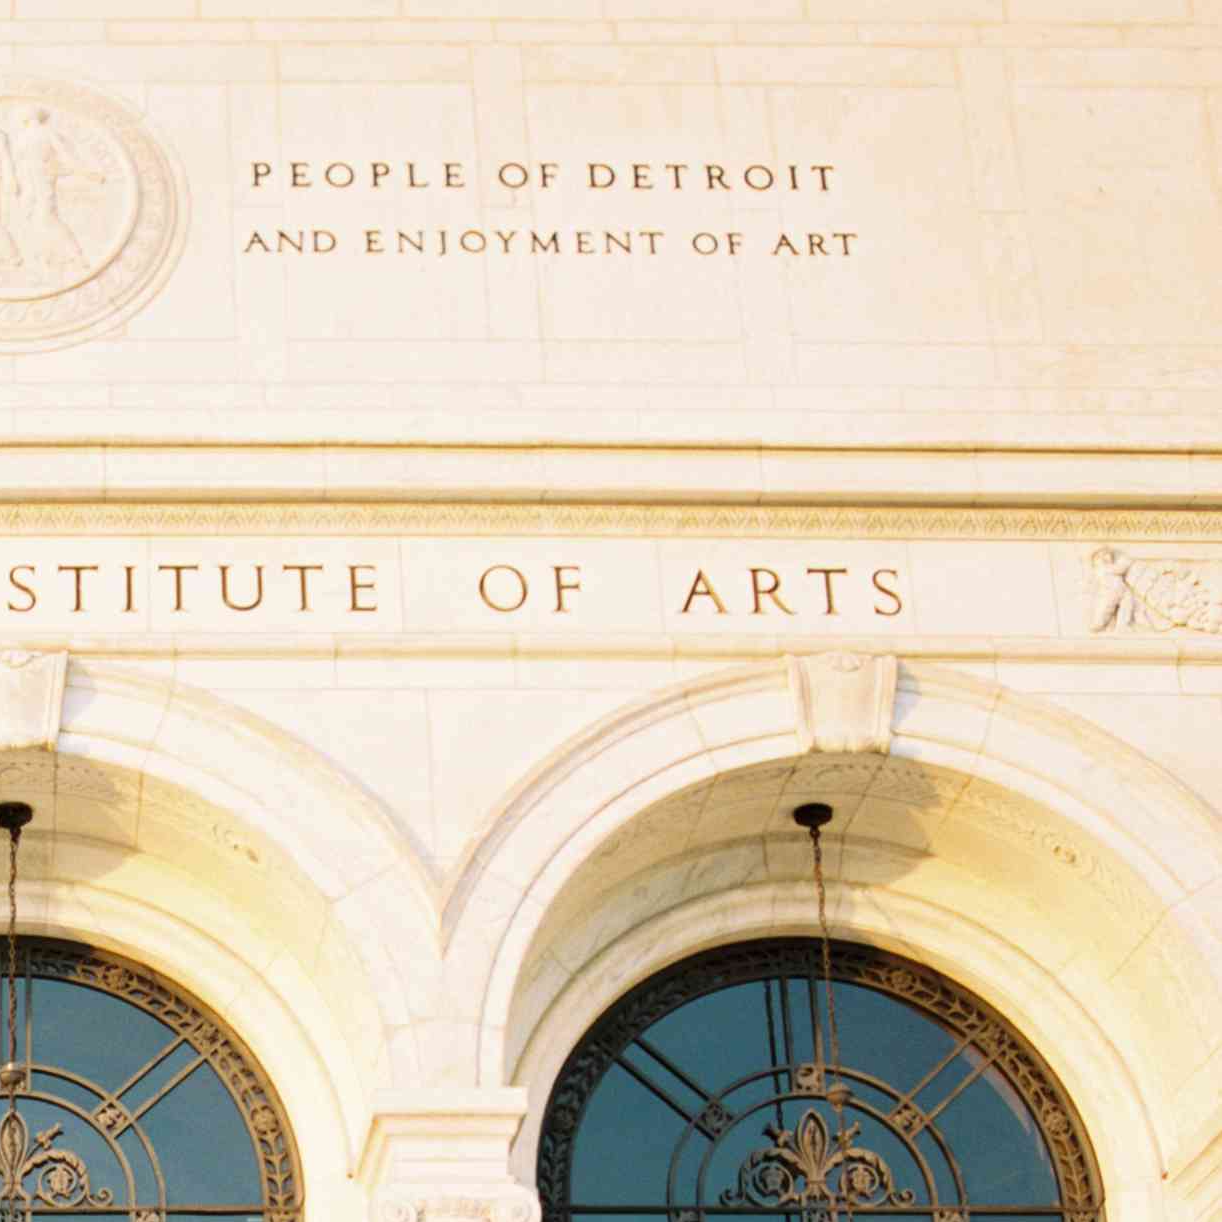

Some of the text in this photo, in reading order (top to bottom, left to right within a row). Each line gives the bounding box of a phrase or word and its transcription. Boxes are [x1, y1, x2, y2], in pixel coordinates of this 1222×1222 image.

[252, 162, 465, 189] PEOPLE
[497, 162, 558, 190] OF
[587, 162, 834, 192] DETROIT
[243, 230, 337, 254] AND
[365, 229, 664, 256] ENJOYMENT
[691, 232, 742, 256] OF
[772, 232, 857, 257] ART
[478, 564, 581, 613] OF
[681, 567, 903, 617] ARTS
